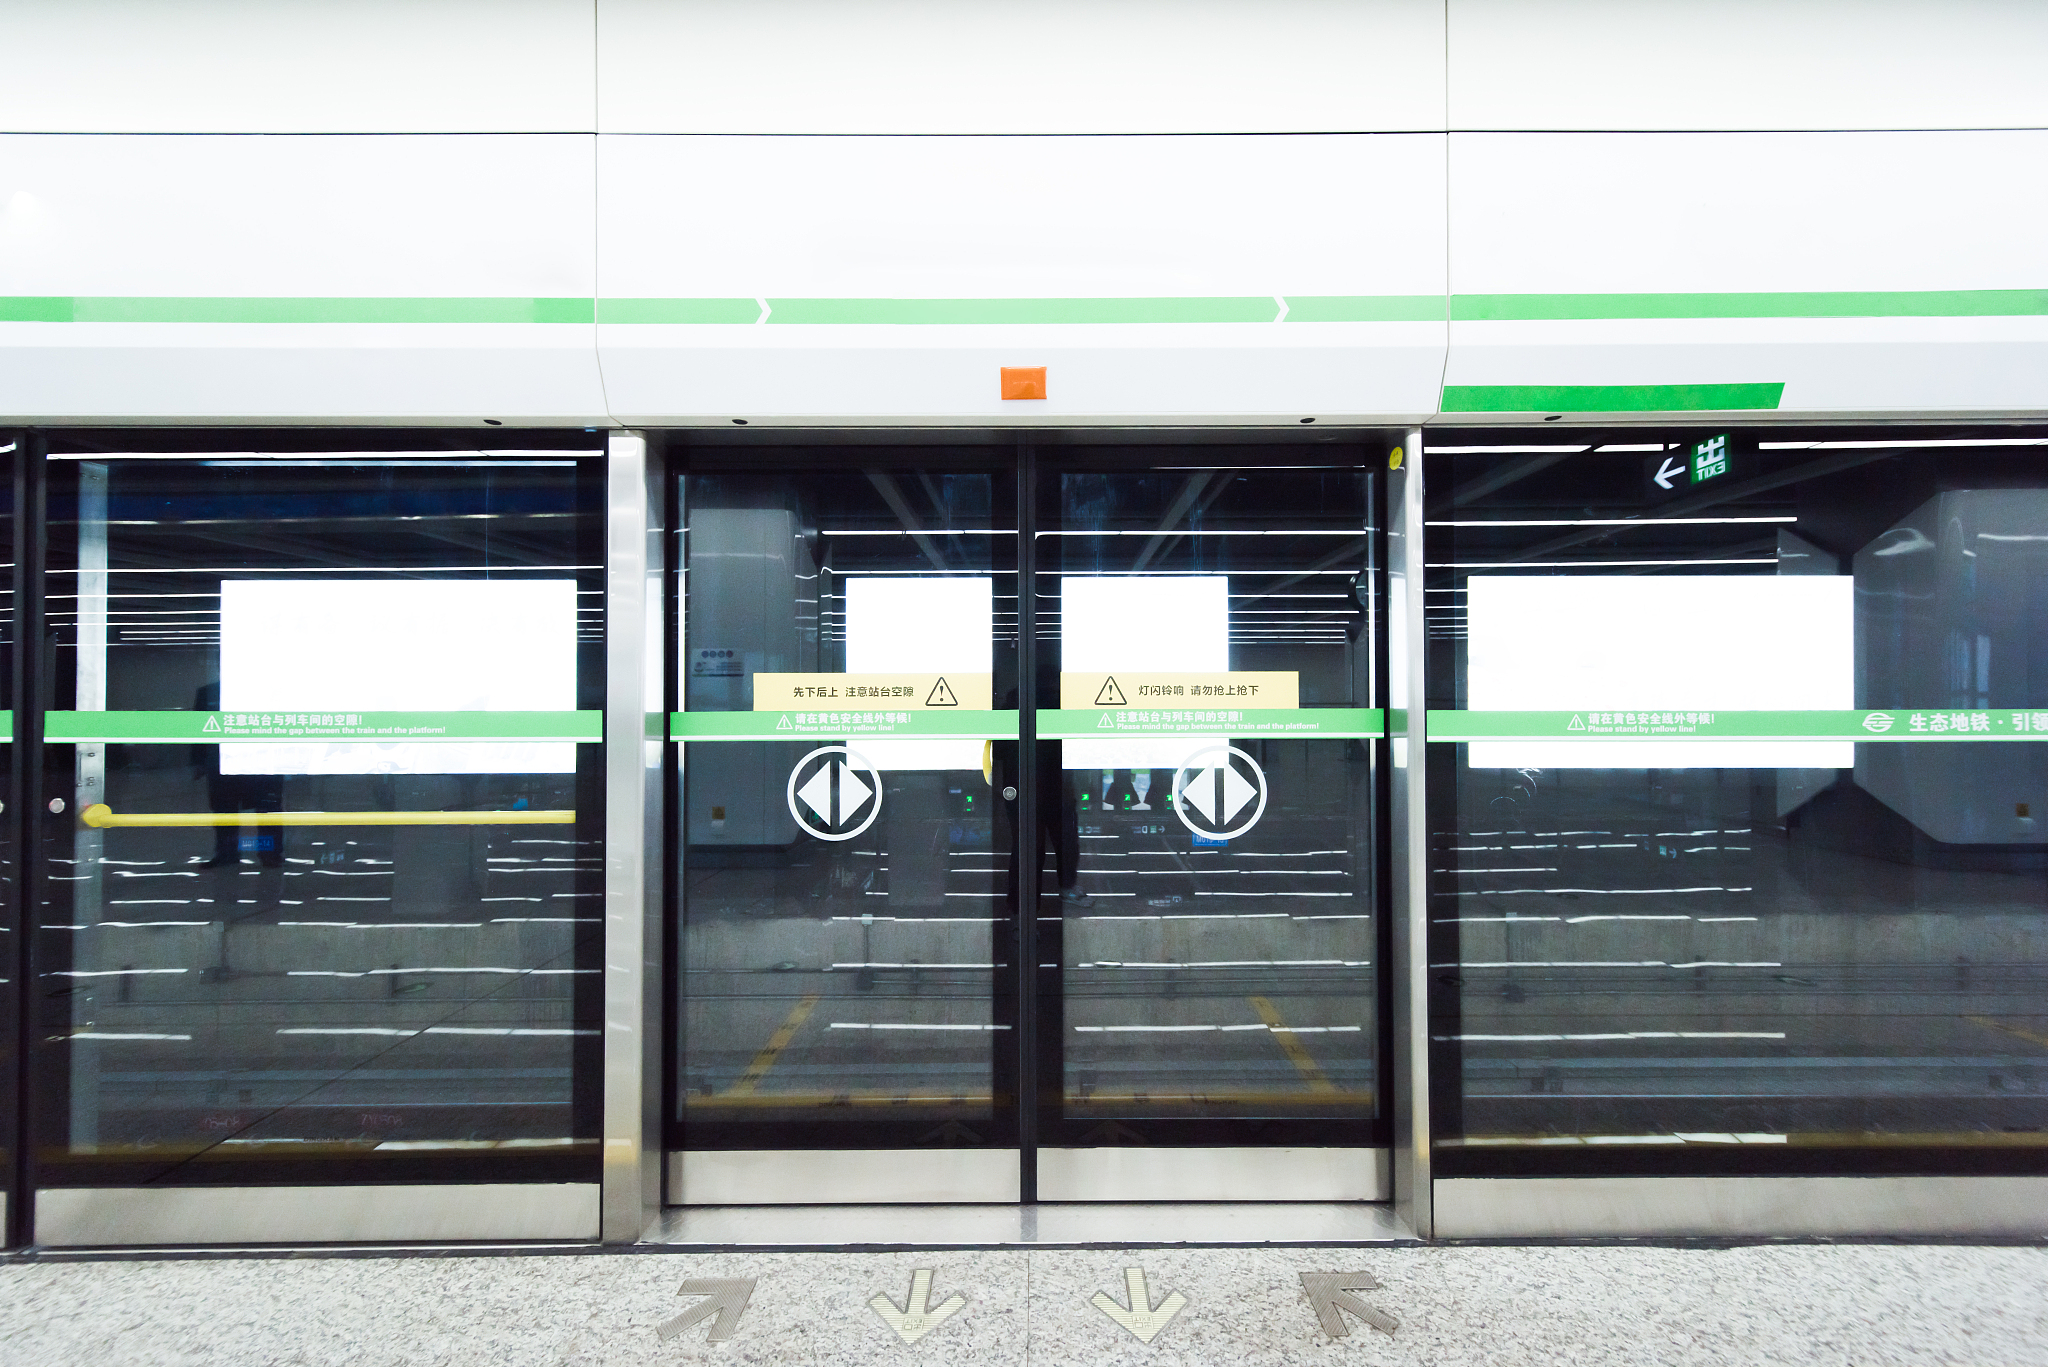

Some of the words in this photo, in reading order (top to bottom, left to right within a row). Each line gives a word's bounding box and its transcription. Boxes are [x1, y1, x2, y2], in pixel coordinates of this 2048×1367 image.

[793, 686, 839, 697] 先下后上
[845, 686, 914, 698] 注意站台空隙
[1138, 685, 1184, 696] 灯闪铃响
[1190, 685, 1259, 696] 请勿抢上抢下
[223, 714, 362, 726] 注意站台与列车间的空隙!
[795, 713, 911, 724] 请在黄色安全线外等候!
[1116, 711, 1243, 723] 注意站台与列车间的空隙!
[1588, 713, 1715, 725] 请在黄色安全线外等候!
[224, 726, 250, 734] Please
[251, 726, 272, 734] mind
[274, 726, 287, 734] the
[289, 726, 304, 736] gap
[305, 726, 340, 734] between
[342, 726, 355, 734] the
[356, 726, 375, 734] train
[377, 726, 392, 734] and
[394, 726, 407, 734] the
[408, 726, 446, 736] platform!
[841, 725, 851, 733] by
[852, 725, 877, 733] yellow
[1176, 723, 1189, 732] gap
[1285, 723, 1319, 732] platform!
[1639, 726, 1649, 734] by
[1650, 726, 1677, 734] yellow
